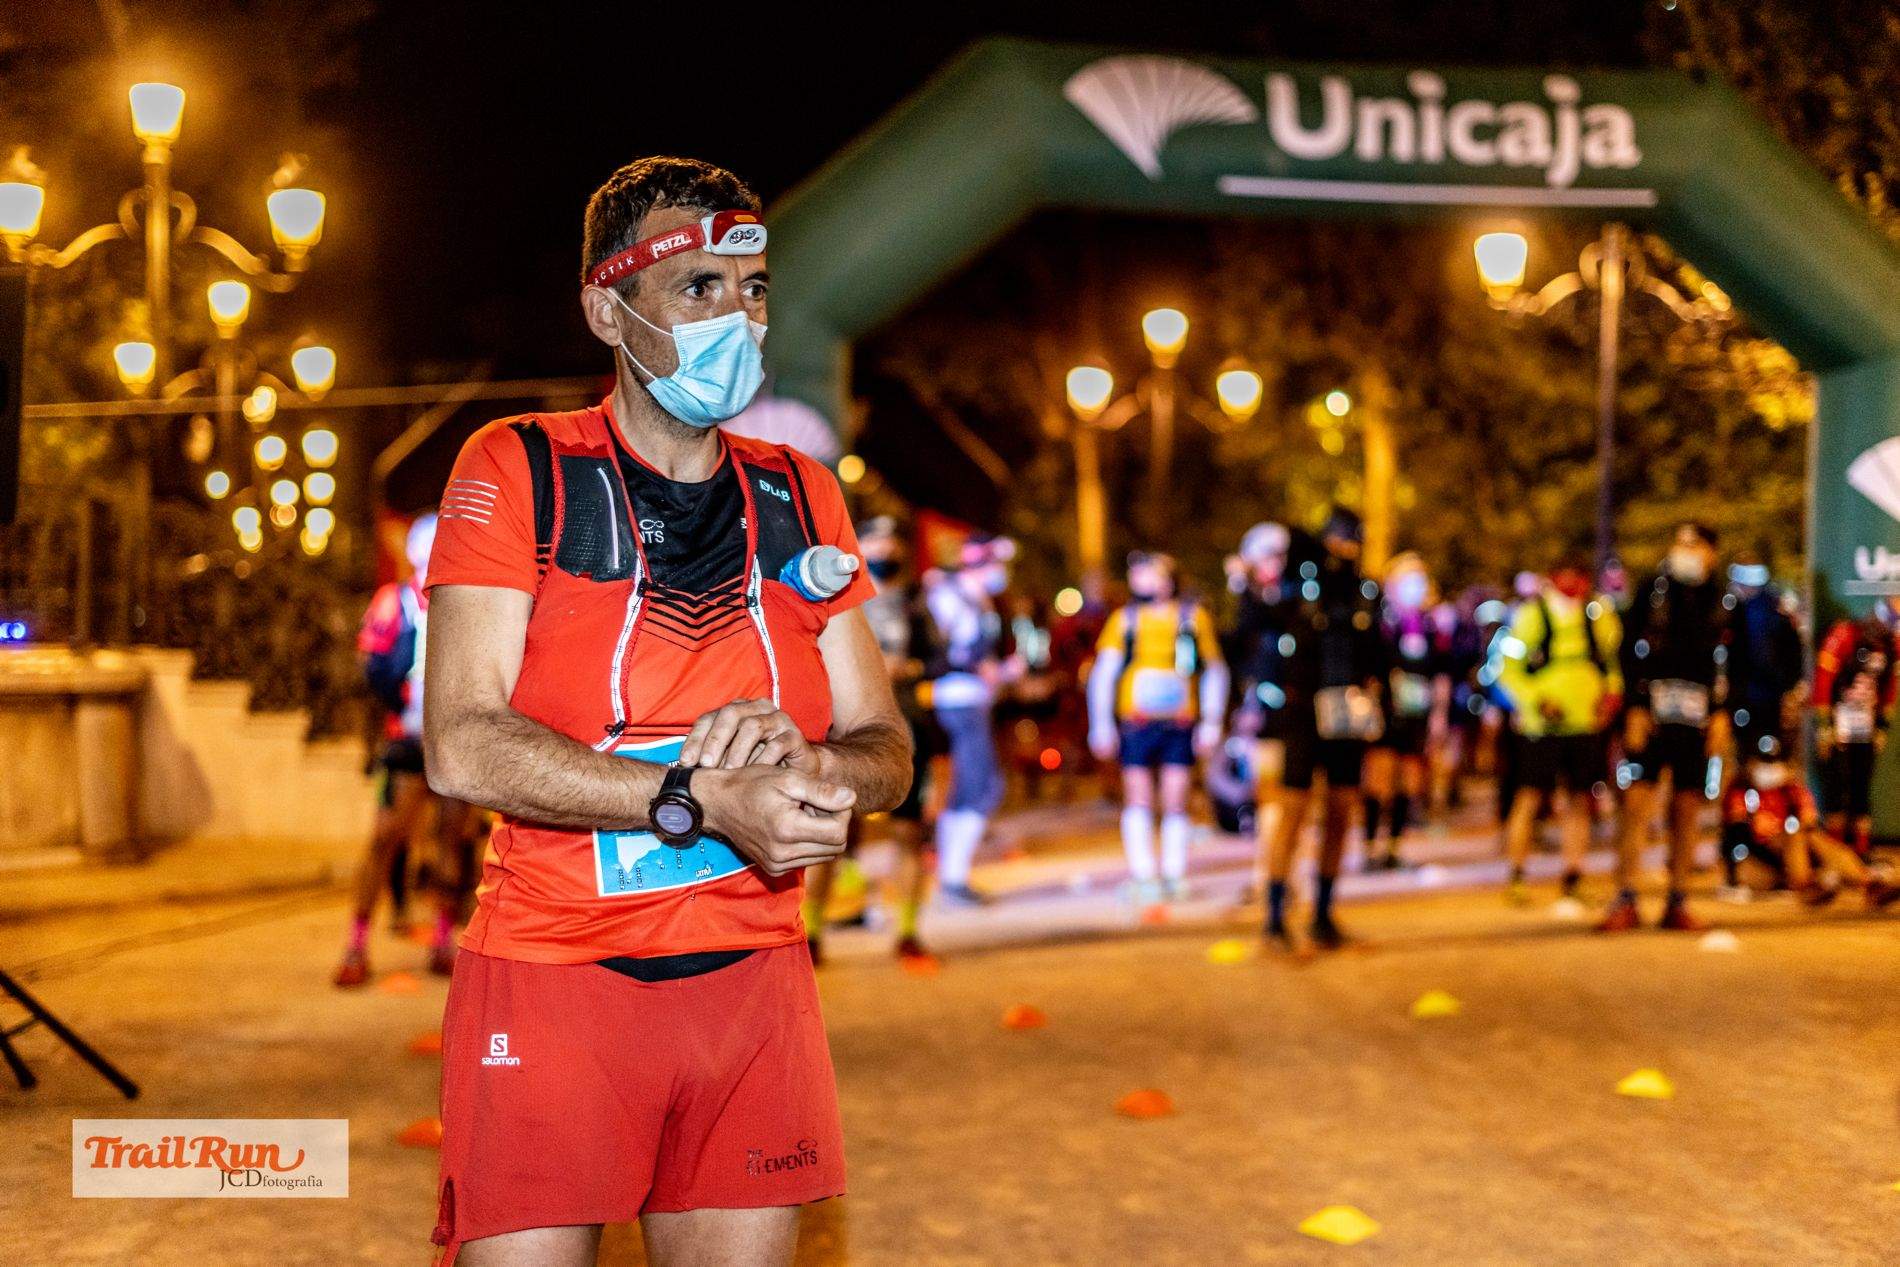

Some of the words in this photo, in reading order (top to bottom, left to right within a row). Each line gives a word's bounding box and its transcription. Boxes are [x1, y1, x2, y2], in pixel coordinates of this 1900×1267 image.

[1264, 68, 1643, 189] Unicaja
[651, 234, 693, 259] PETZL
[593, 256, 635, 286] ACTIK
[481, 1056, 520, 1066] salomon
